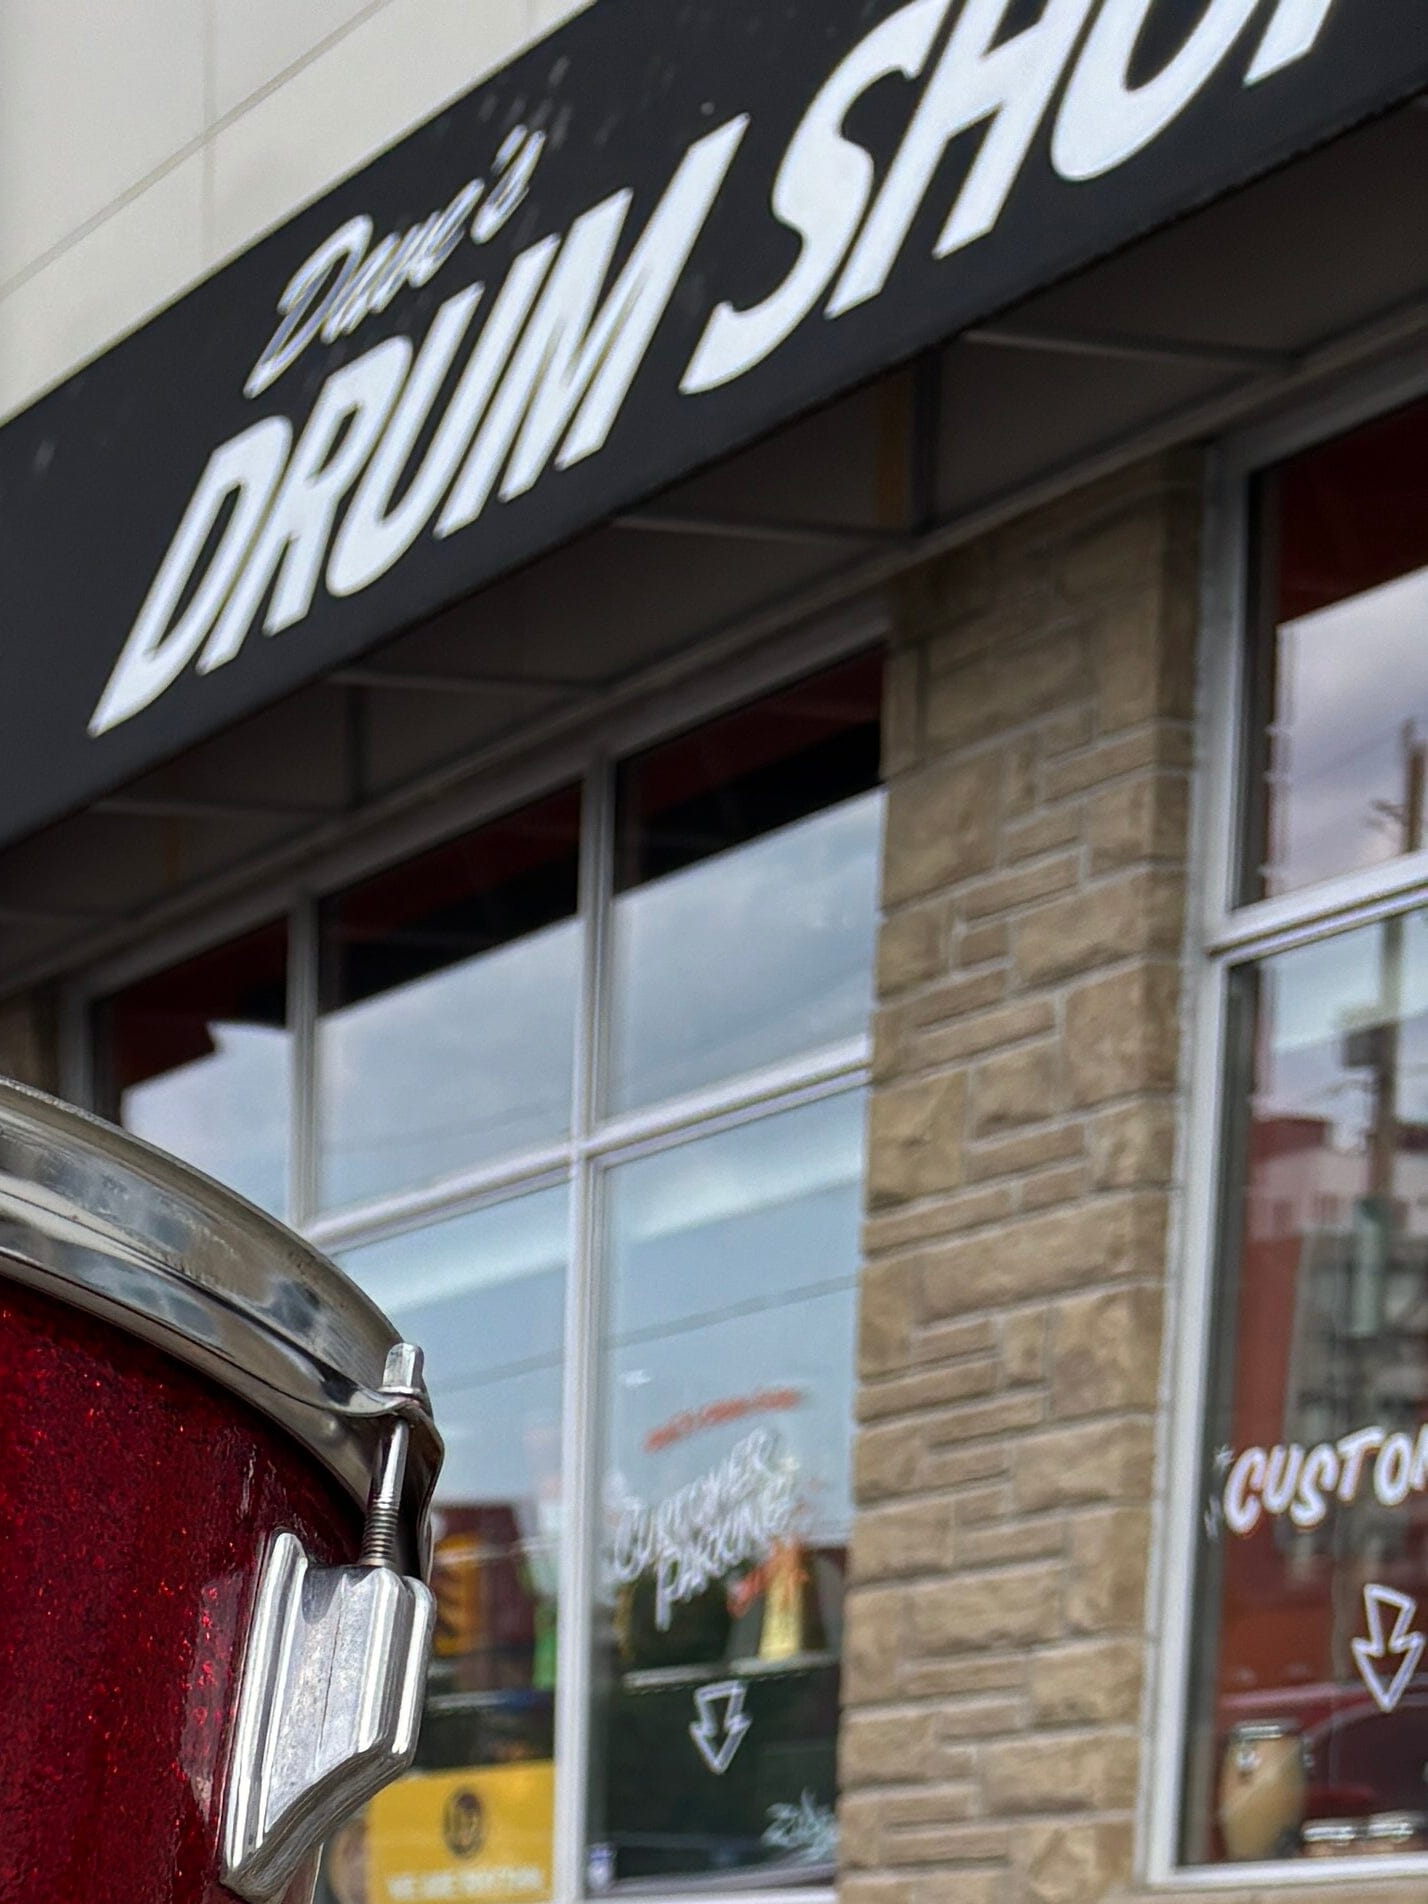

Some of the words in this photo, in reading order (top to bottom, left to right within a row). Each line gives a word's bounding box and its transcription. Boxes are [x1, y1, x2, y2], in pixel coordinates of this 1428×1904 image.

[87, 114, 749, 738] DRUM
[678, 0, 1333, 394] SHO
[243, 124, 546, 399] Dave's
